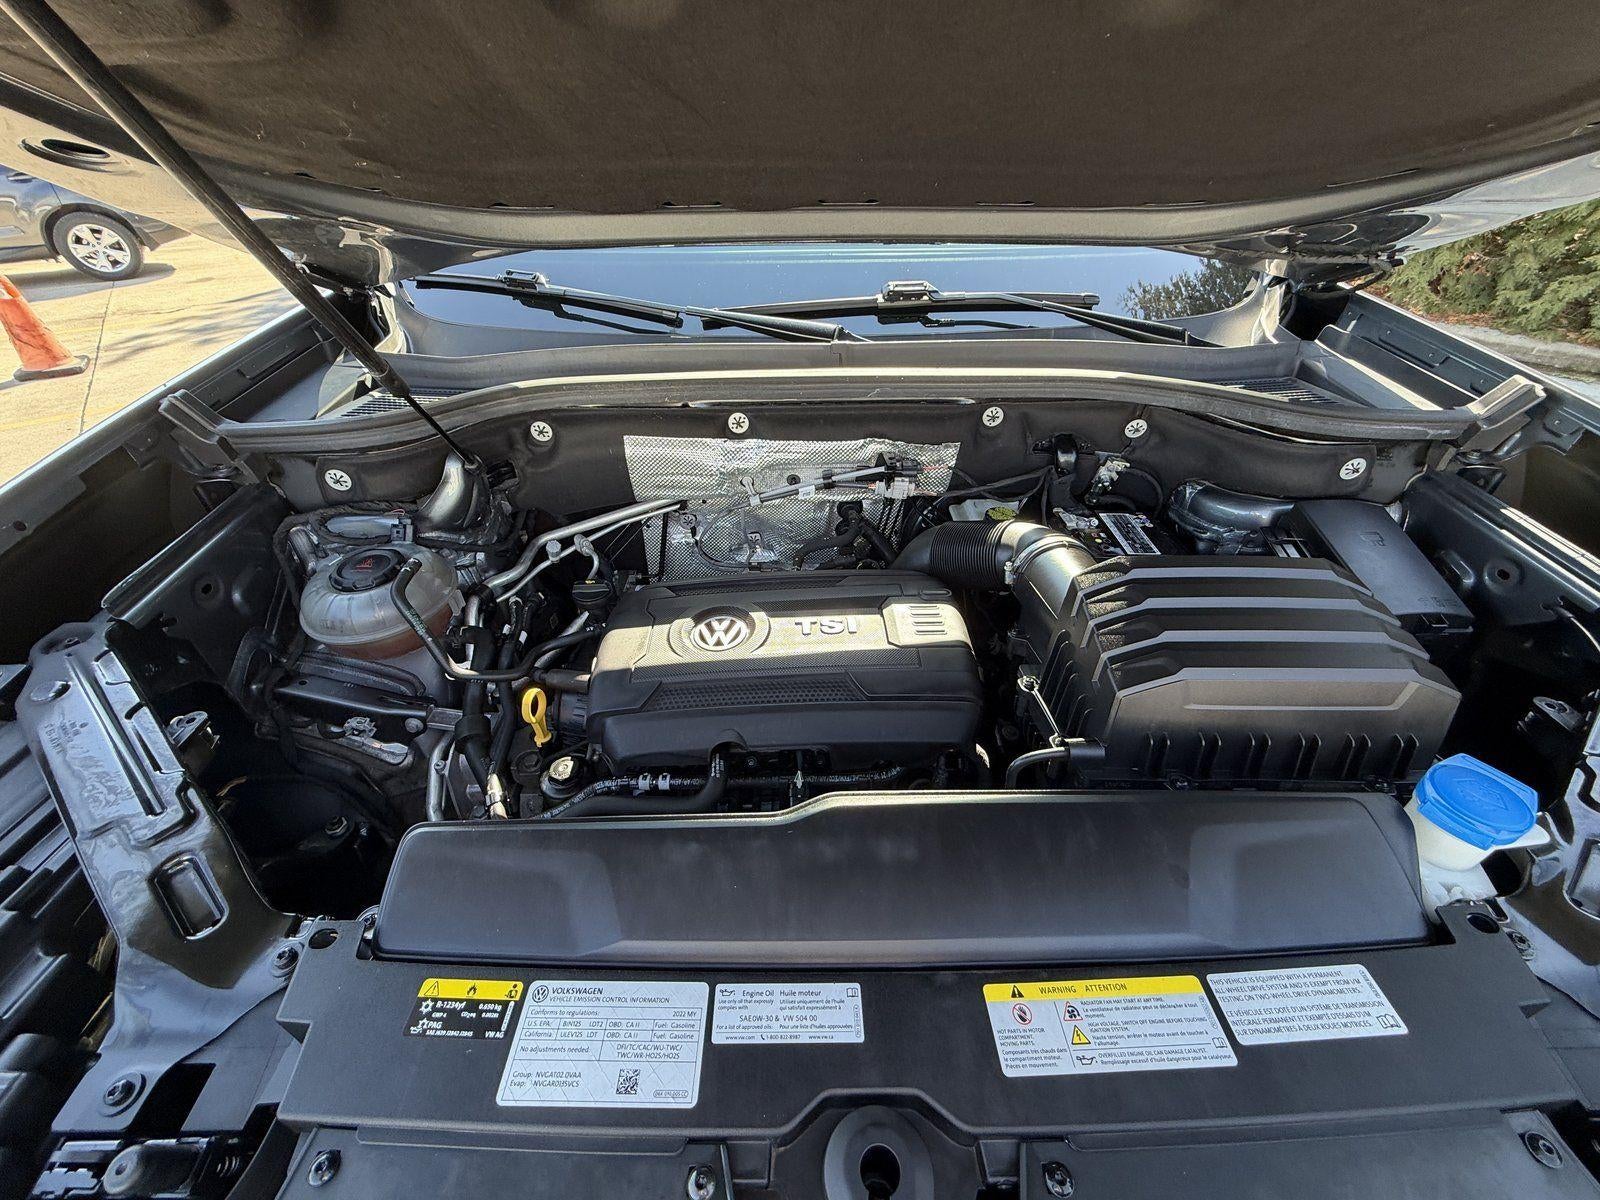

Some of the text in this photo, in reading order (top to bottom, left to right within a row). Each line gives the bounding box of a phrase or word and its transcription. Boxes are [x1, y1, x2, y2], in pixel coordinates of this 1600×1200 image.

[795, 616, 857, 636] TSI
[551, 987, 603, 995] VOLKSWAGEN
[1038, 983, 1128, 995] WARNING ATTENTION
[743, 990, 764, 998] Engine
[1254, 992, 1292, 1000] TWO-WHEEL
[1234, 1008, 1263, 1016] VÉHICULE
[1341, 1000, 1384, 1008] TRANSMISSION
[427, 1021, 443, 1029] PAG
[529, 1046, 567, 1054] adjustments
[512, 1071, 534, 1079] Group:
[509, 1080, 527, 1088] Evap:
